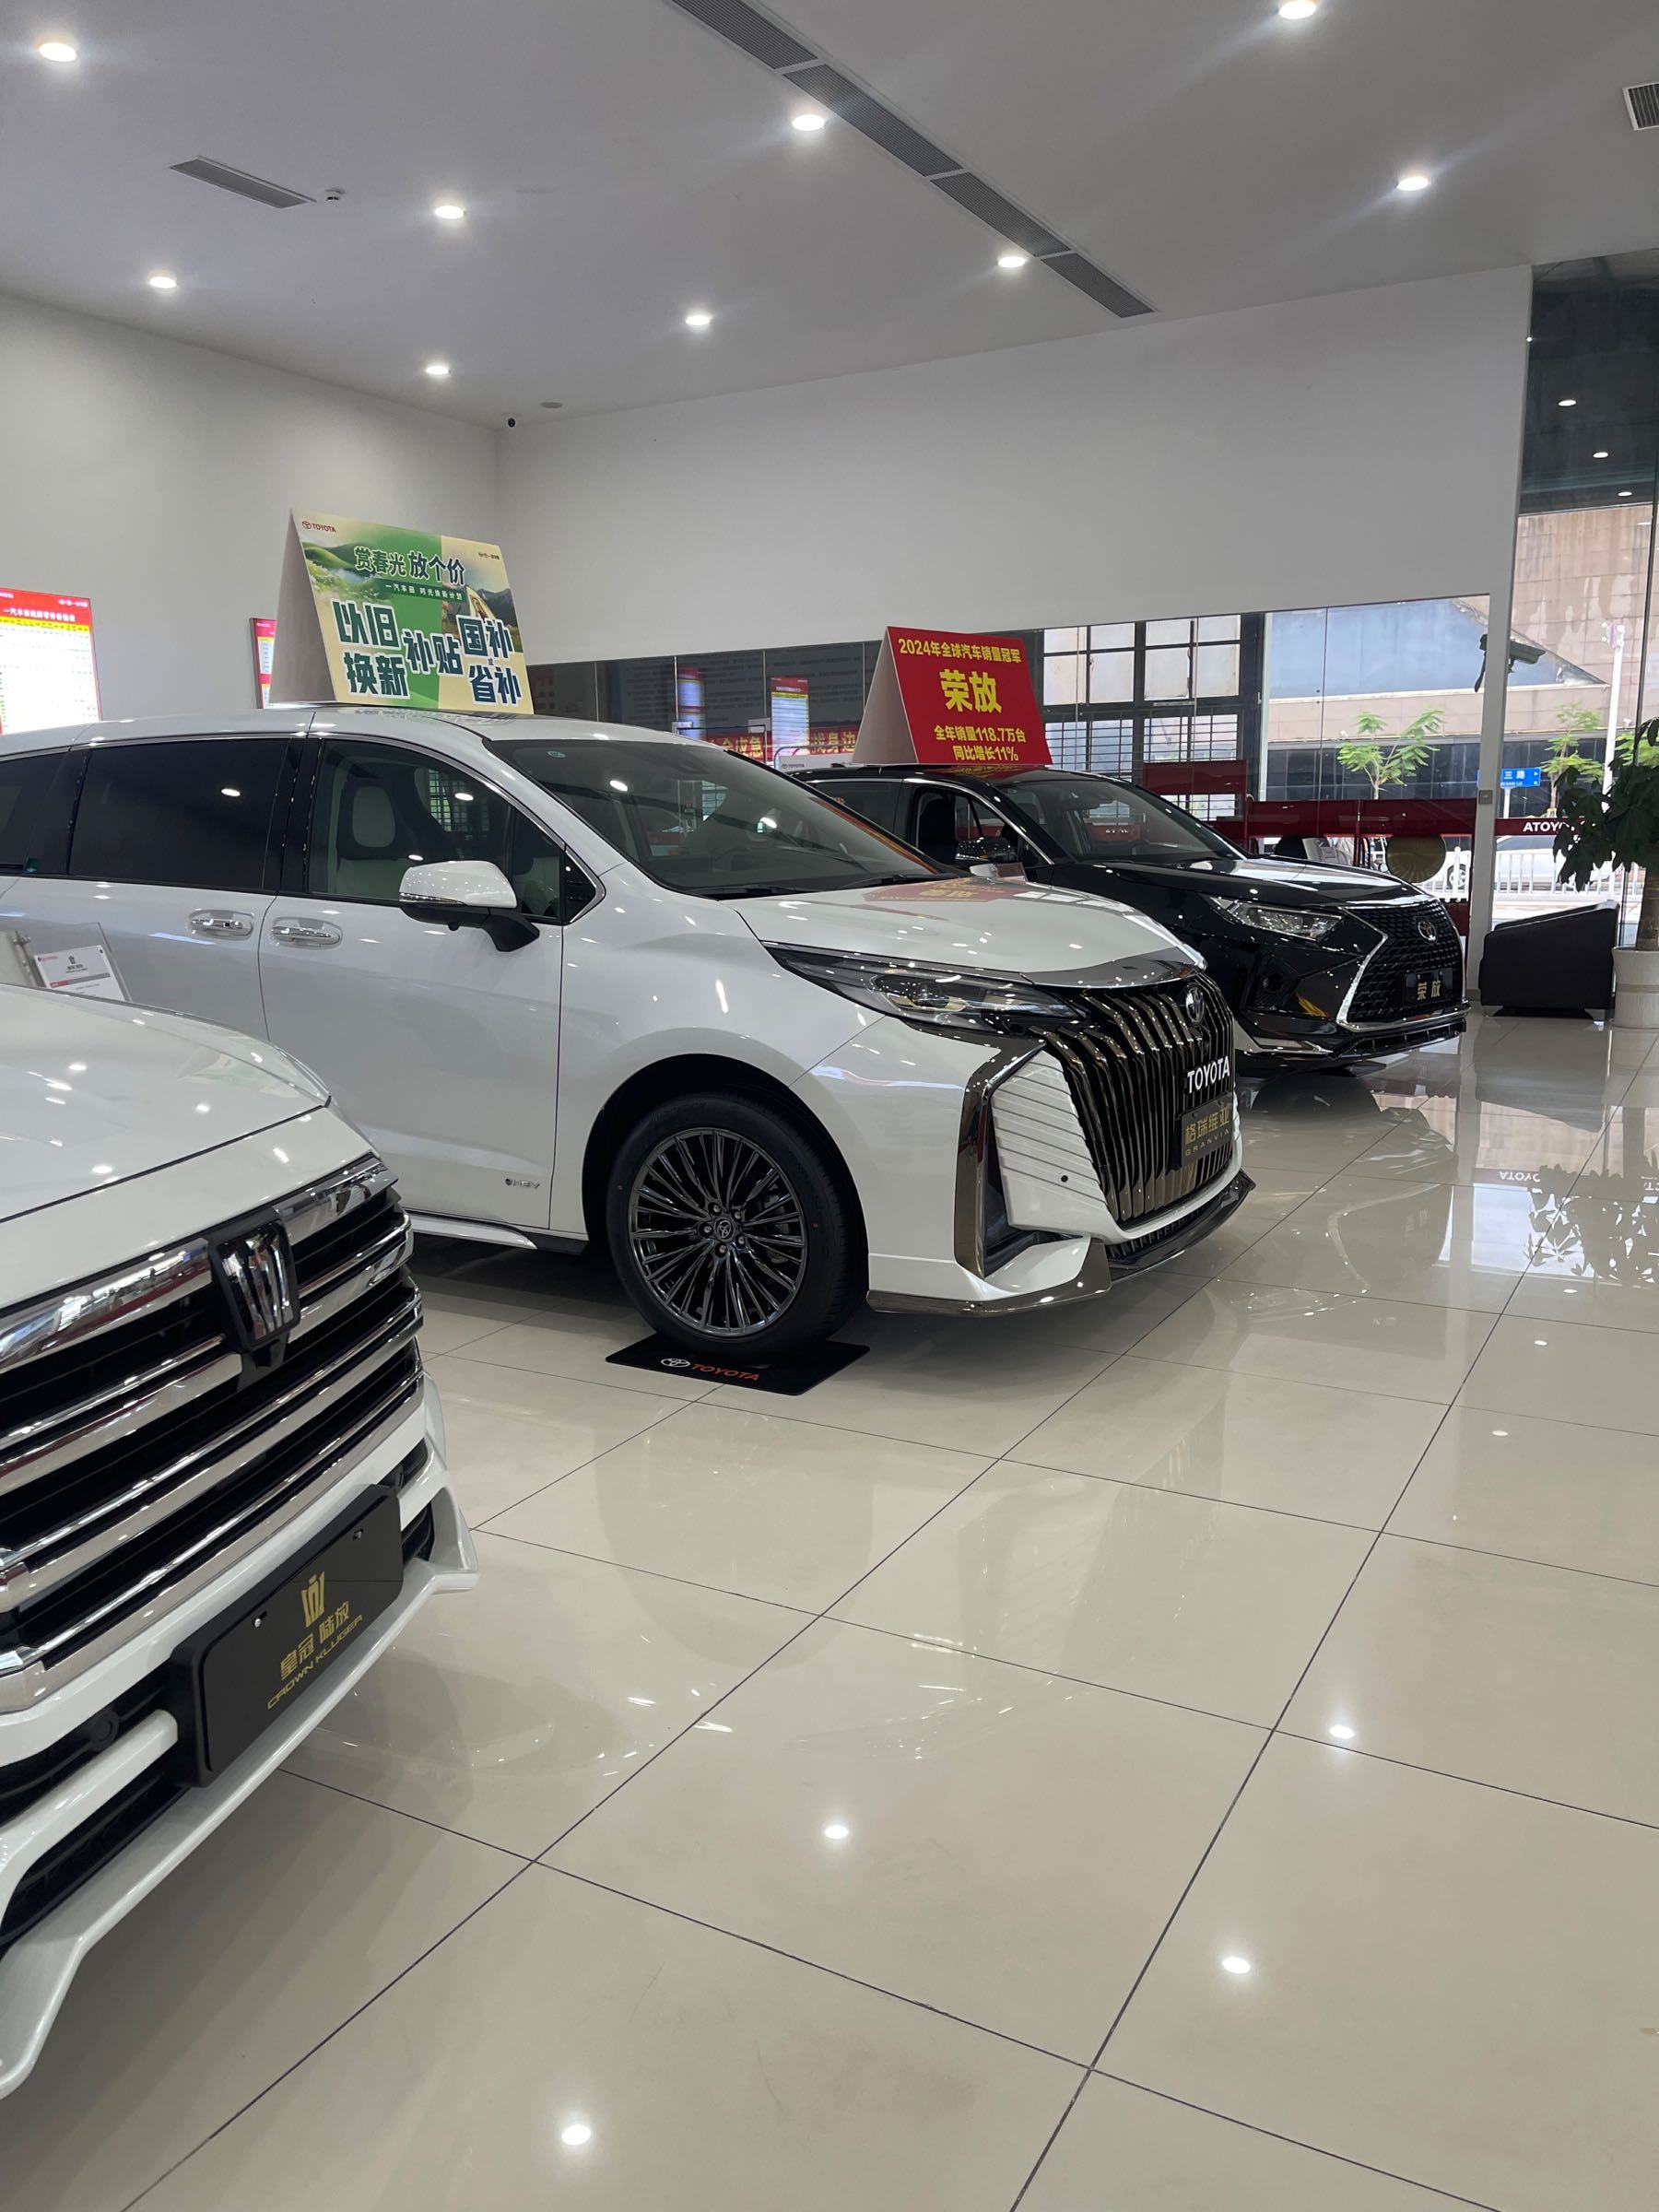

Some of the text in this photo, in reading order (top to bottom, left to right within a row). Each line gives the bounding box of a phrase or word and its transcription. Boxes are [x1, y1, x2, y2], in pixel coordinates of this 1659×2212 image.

[312, 523, 336, 533] TOYOTA
[353, 547, 465, 586] 赏春光 放个价
[331, 600, 401, 649] 以旧
[457, 616, 513, 658] 国补
[403, 630, 464, 677] 补贴
[898, 638, 1022, 664] 2024年全球汽车销量冠军
[343, 652, 410, 699] 换新
[468, 665, 523, 706] 省补
[938, 668, 1003, 714] 荣放
[934, 724, 1027, 743] 全年销量118.7万台
[952, 745, 1019, 761] 同比增长11%
[1417, 980, 1441, 1001] 荣放
[1187, 1055, 1230, 1094] TOYOTA
[1184, 1106, 1230, 1146] 格瑞维亚
[1184, 1128, 1230, 1157] GRANVIA
[691, 1363, 760, 1381] TOYOTA
[280, 1600, 349, 1681] 皇冠 陆放
[267, 1614, 363, 1711] CROWN KLUGER
